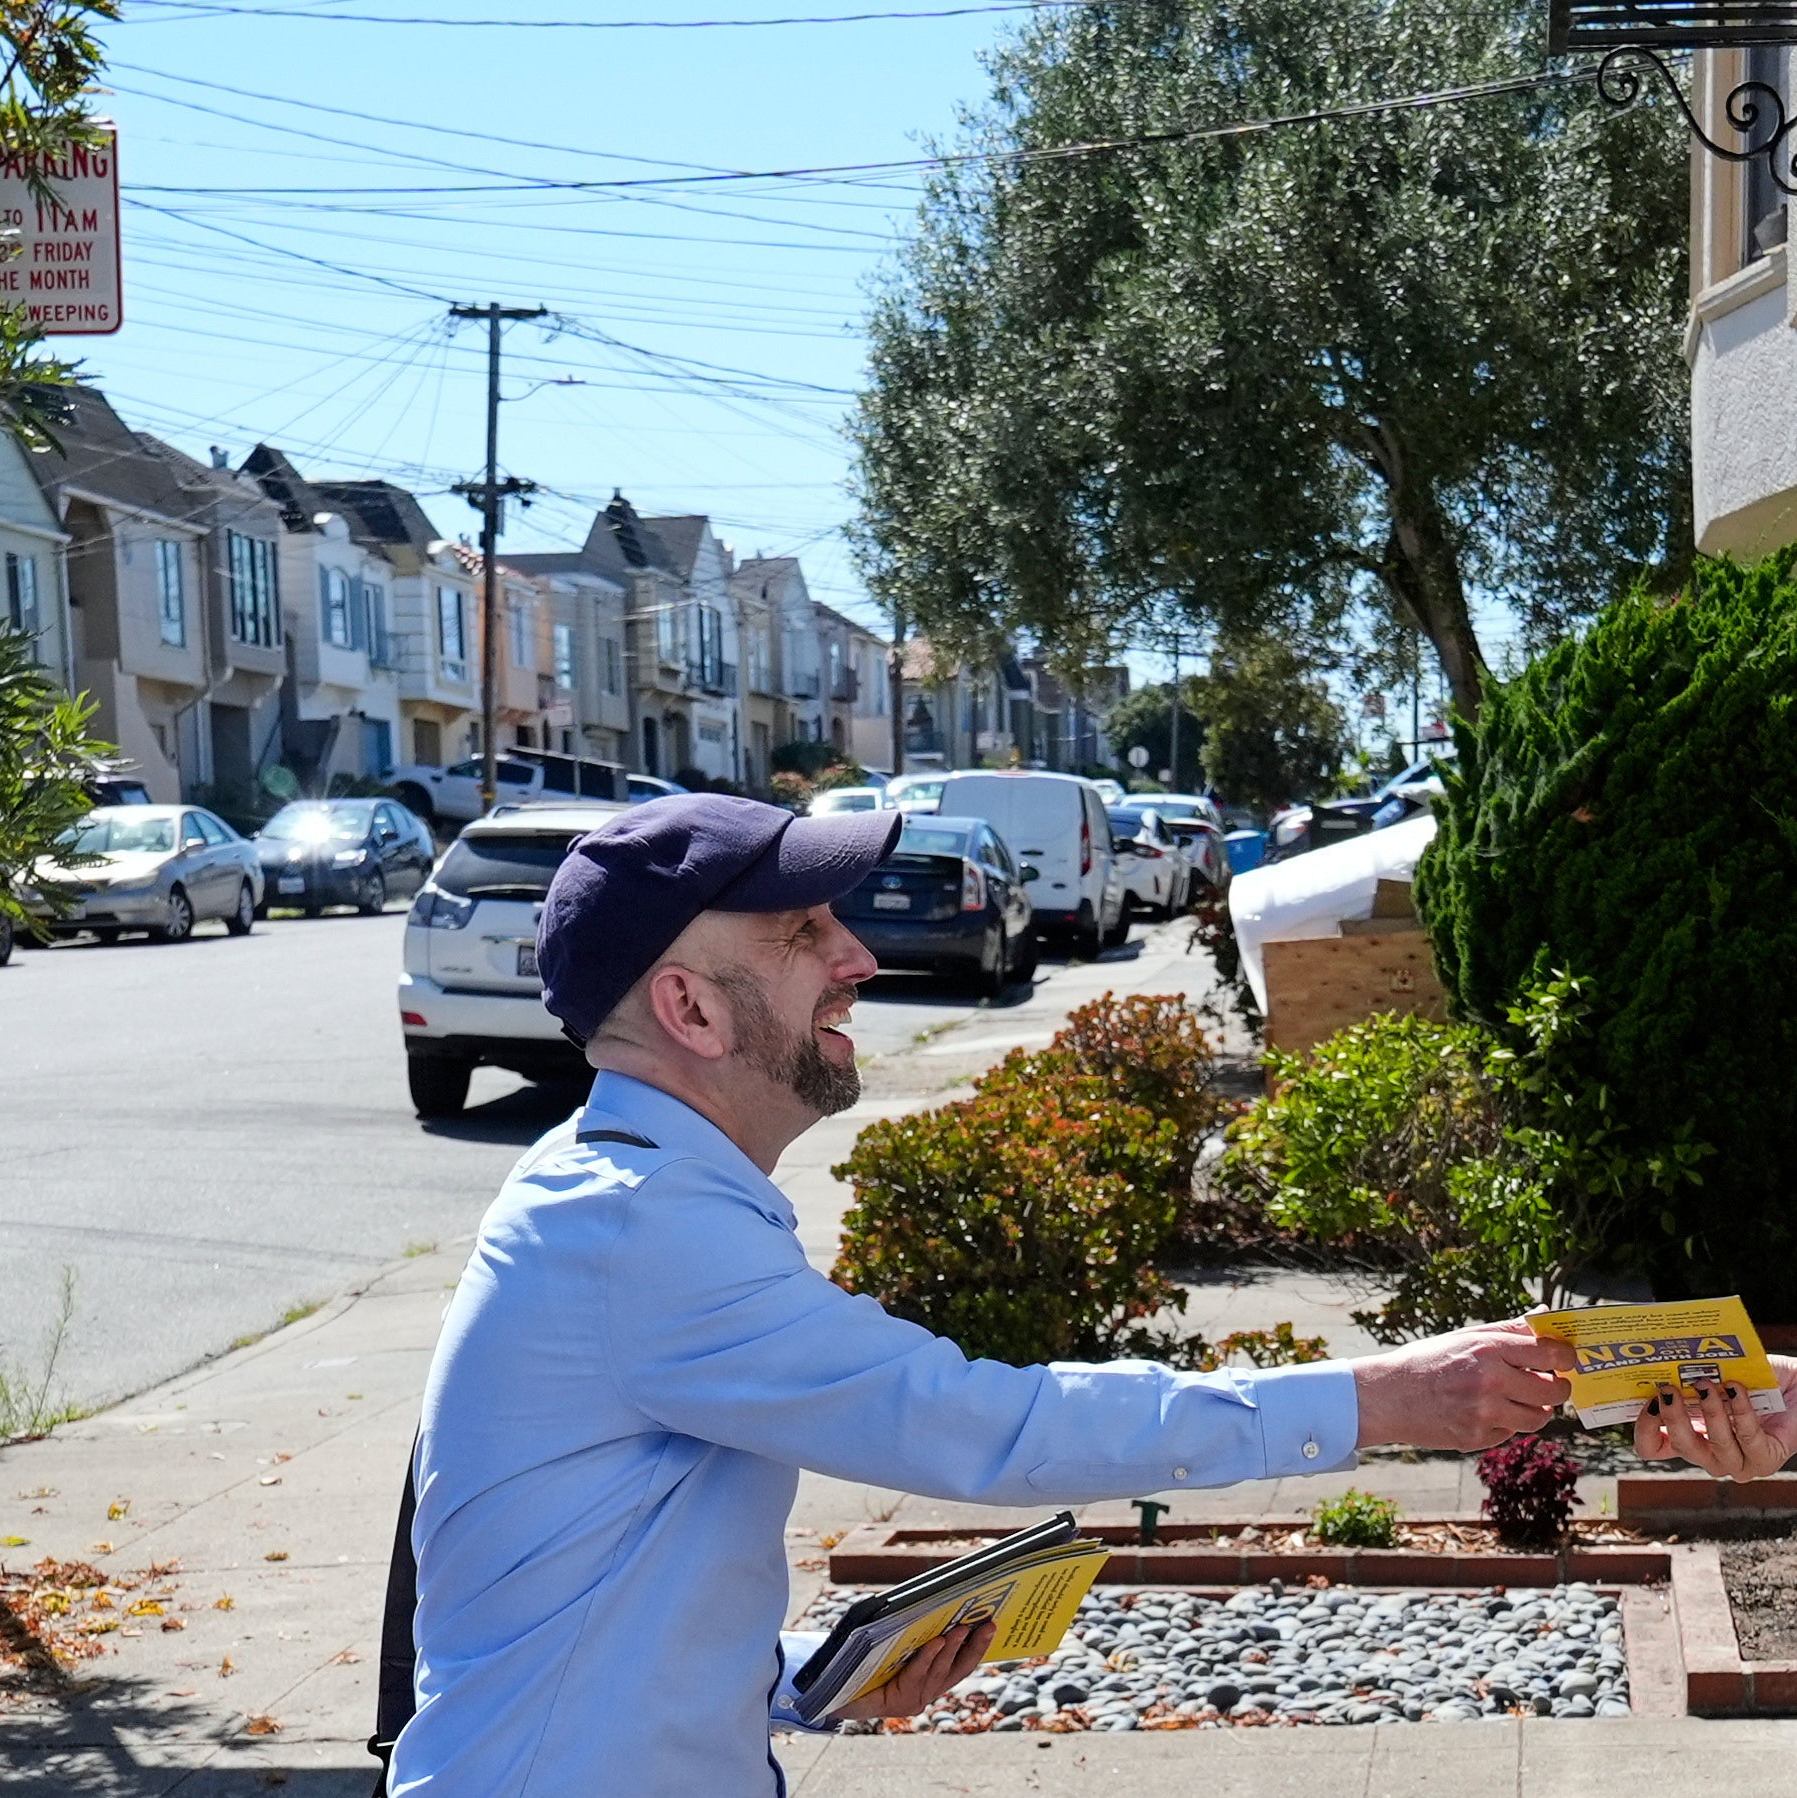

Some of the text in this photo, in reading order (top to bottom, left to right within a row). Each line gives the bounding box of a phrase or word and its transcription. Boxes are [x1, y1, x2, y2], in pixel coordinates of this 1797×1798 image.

[3, 208, 23, 226] TO
[33, 241, 93, 262] FRIDAY
[30, 269, 89, 290] MONTH
[1577, 1342, 1654, 1365] NO
[1659, 1347, 1691, 1356] on
[1697, 1337, 1733, 1353] A
[1583, 1349, 1739, 1372] STAND WITH JOEL
